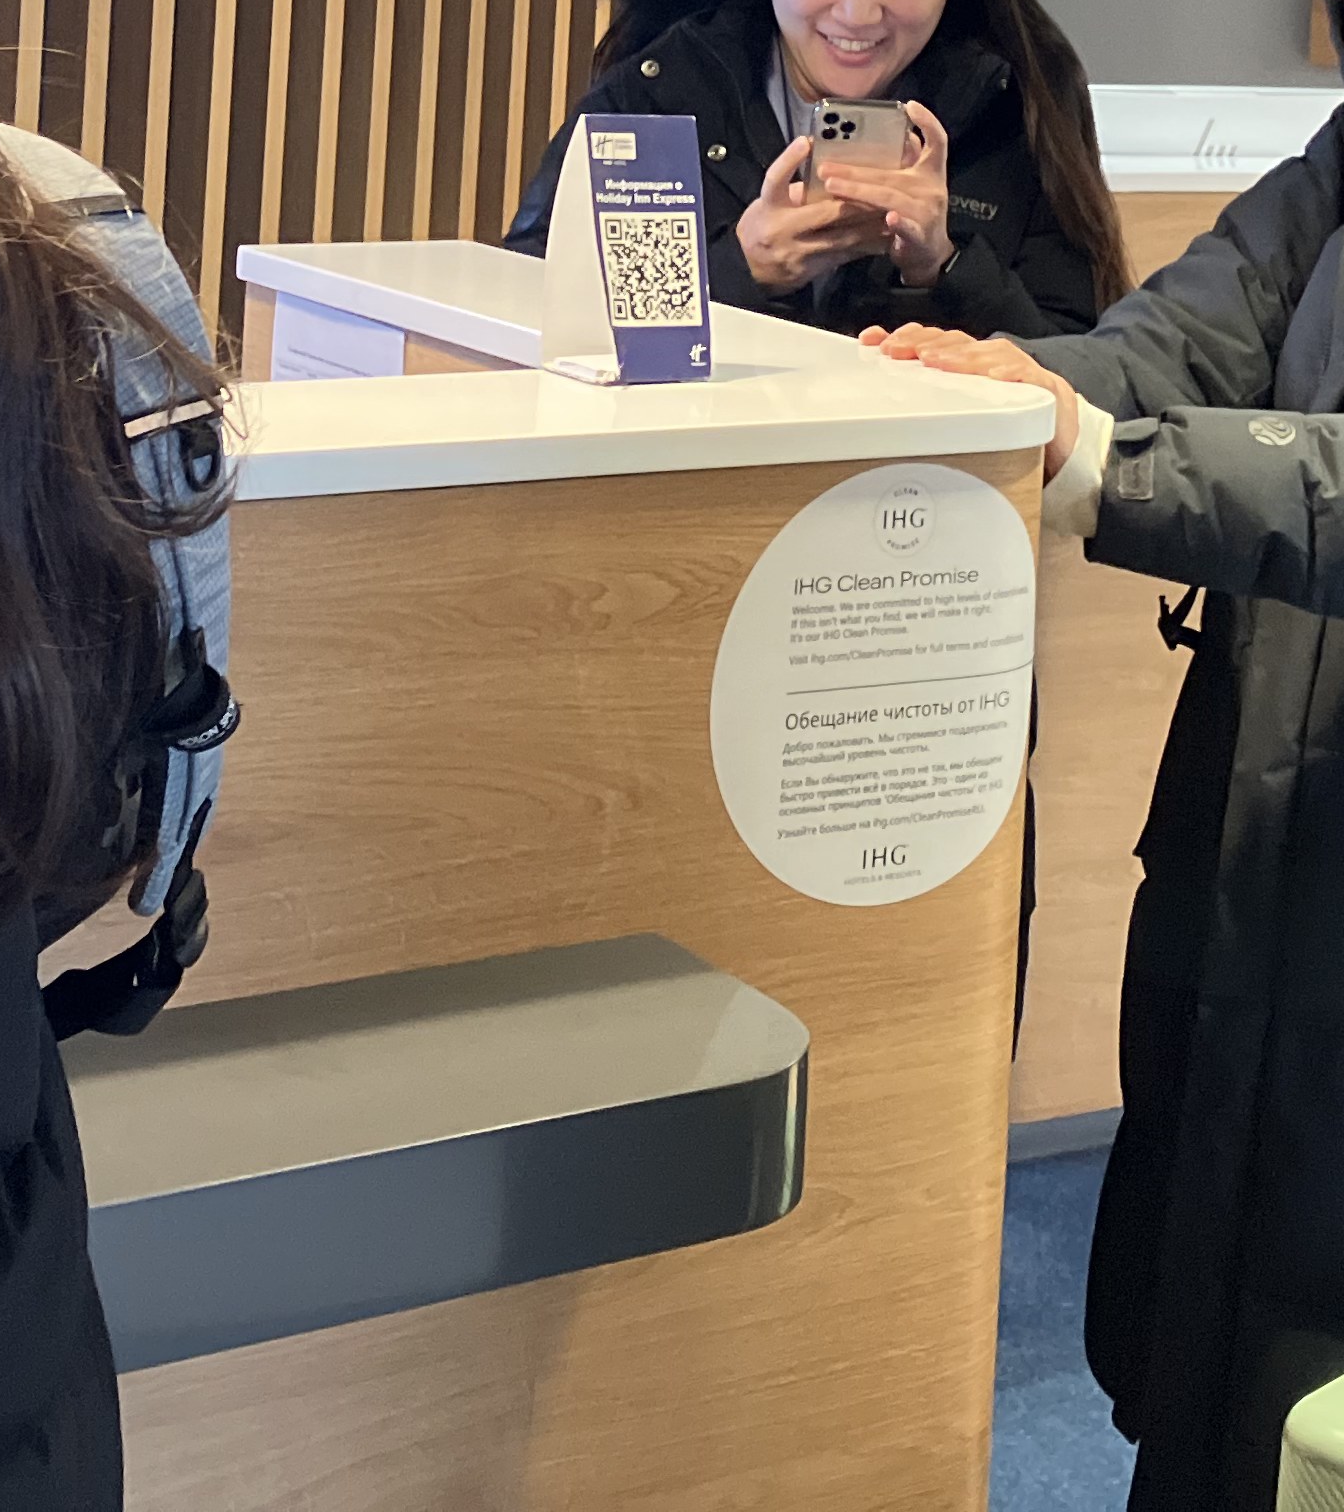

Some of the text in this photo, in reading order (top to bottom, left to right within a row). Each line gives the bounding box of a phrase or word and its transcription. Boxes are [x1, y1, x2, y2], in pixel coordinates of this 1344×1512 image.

[604, 178, 684, 193] Информация о
[596, 192, 696, 206] Holiday Inn Express
[883, 508, 928, 529] IHG
[794, 568, 979, 595] IHG Clean Promise
[840, 602, 854, 611] We
[856, 602, 870, 610] are
[872, 596, 921, 609] committed
[923, 597, 933, 605] to
[935, 595, 955, 606] high
[957, 592, 981, 602] levels
[983, 591, 991, 600] of
[791, 619, 797, 629] If
[799, 619, 816, 628] this
[819, 617, 837, 627] isn't
[840, 615, 861, 625] what
[864, 615, 881, 625] you
[921, 608, 935, 618] will
[938, 607, 961, 617] make
[963, 606, 969, 615] it
[790, 633, 803, 643] It's
[805, 633, 821, 642] our
[823, 629, 840, 640] IHG
[843, 628, 868, 639] Clean
[789, 655, 808, 665] Visit
[915, 644, 927, 654] for
[930, 643, 944, 653] full
[946, 643, 971, 652] terms
[973, 638, 988, 650] and
[785, 690, 1010, 730] Обещание чистоты от IHG
[782, 742, 814, 755] Добро
[878, 733, 894, 743] Мы
[897, 729, 947, 743] стремимся
[847, 749, 887, 763] уровень
[781, 779, 803, 790] Если
[882, 768, 899, 777] что
[901, 767, 916, 776] это
[817, 787, 861, 800] привести
[880, 784, 887, 792] в
[932, 776, 948, 786] Это
[955, 773, 977, 783] один
[978, 771, 988, 779] из
[778, 805, 826, 817] основных
[828, 797, 882, 812] принципов
[978, 784, 987, 793] от
[777, 826, 817, 840] Узнайте
[819, 822, 857, 834] больше
[859, 820, 871, 829] на
[862, 844, 909, 869] IHG
